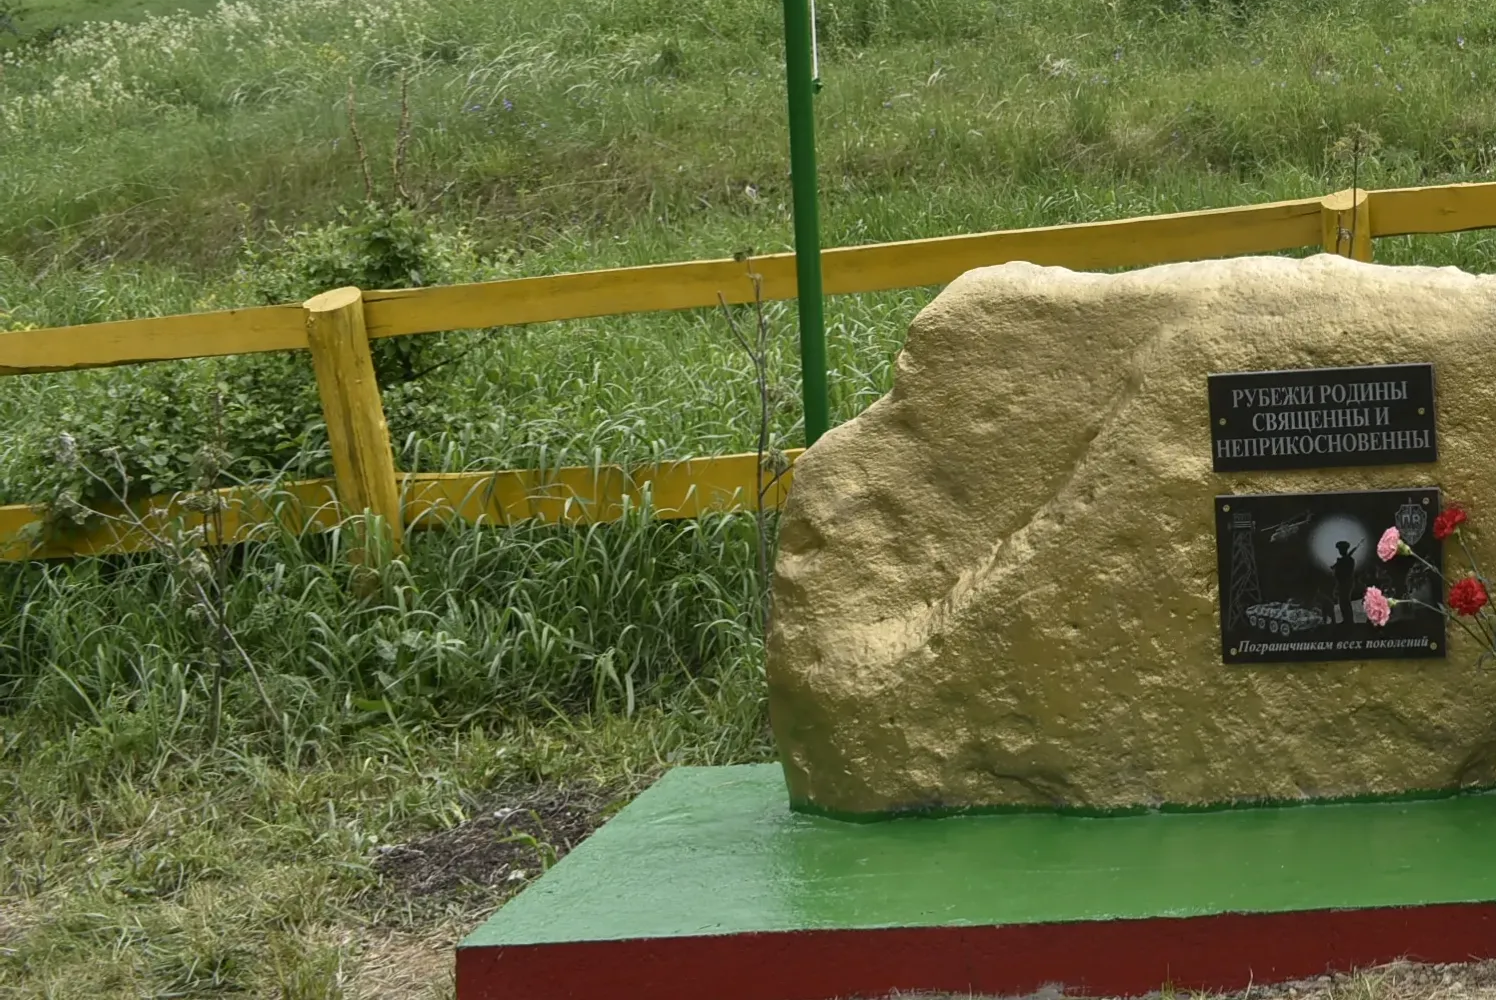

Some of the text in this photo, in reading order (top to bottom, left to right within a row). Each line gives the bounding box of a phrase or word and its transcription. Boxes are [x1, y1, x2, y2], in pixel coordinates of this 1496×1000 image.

[1232, 381, 1408, 408] РУБЕЖИ РОДИНЫ
[1252, 407, 1390, 432] СВЯЩЕННЫ И
[1216, 430, 1431, 458] НЕПРИКОСНОВЕННЫ
[1239, 636, 1429, 655] Пограничникам всех поколений
